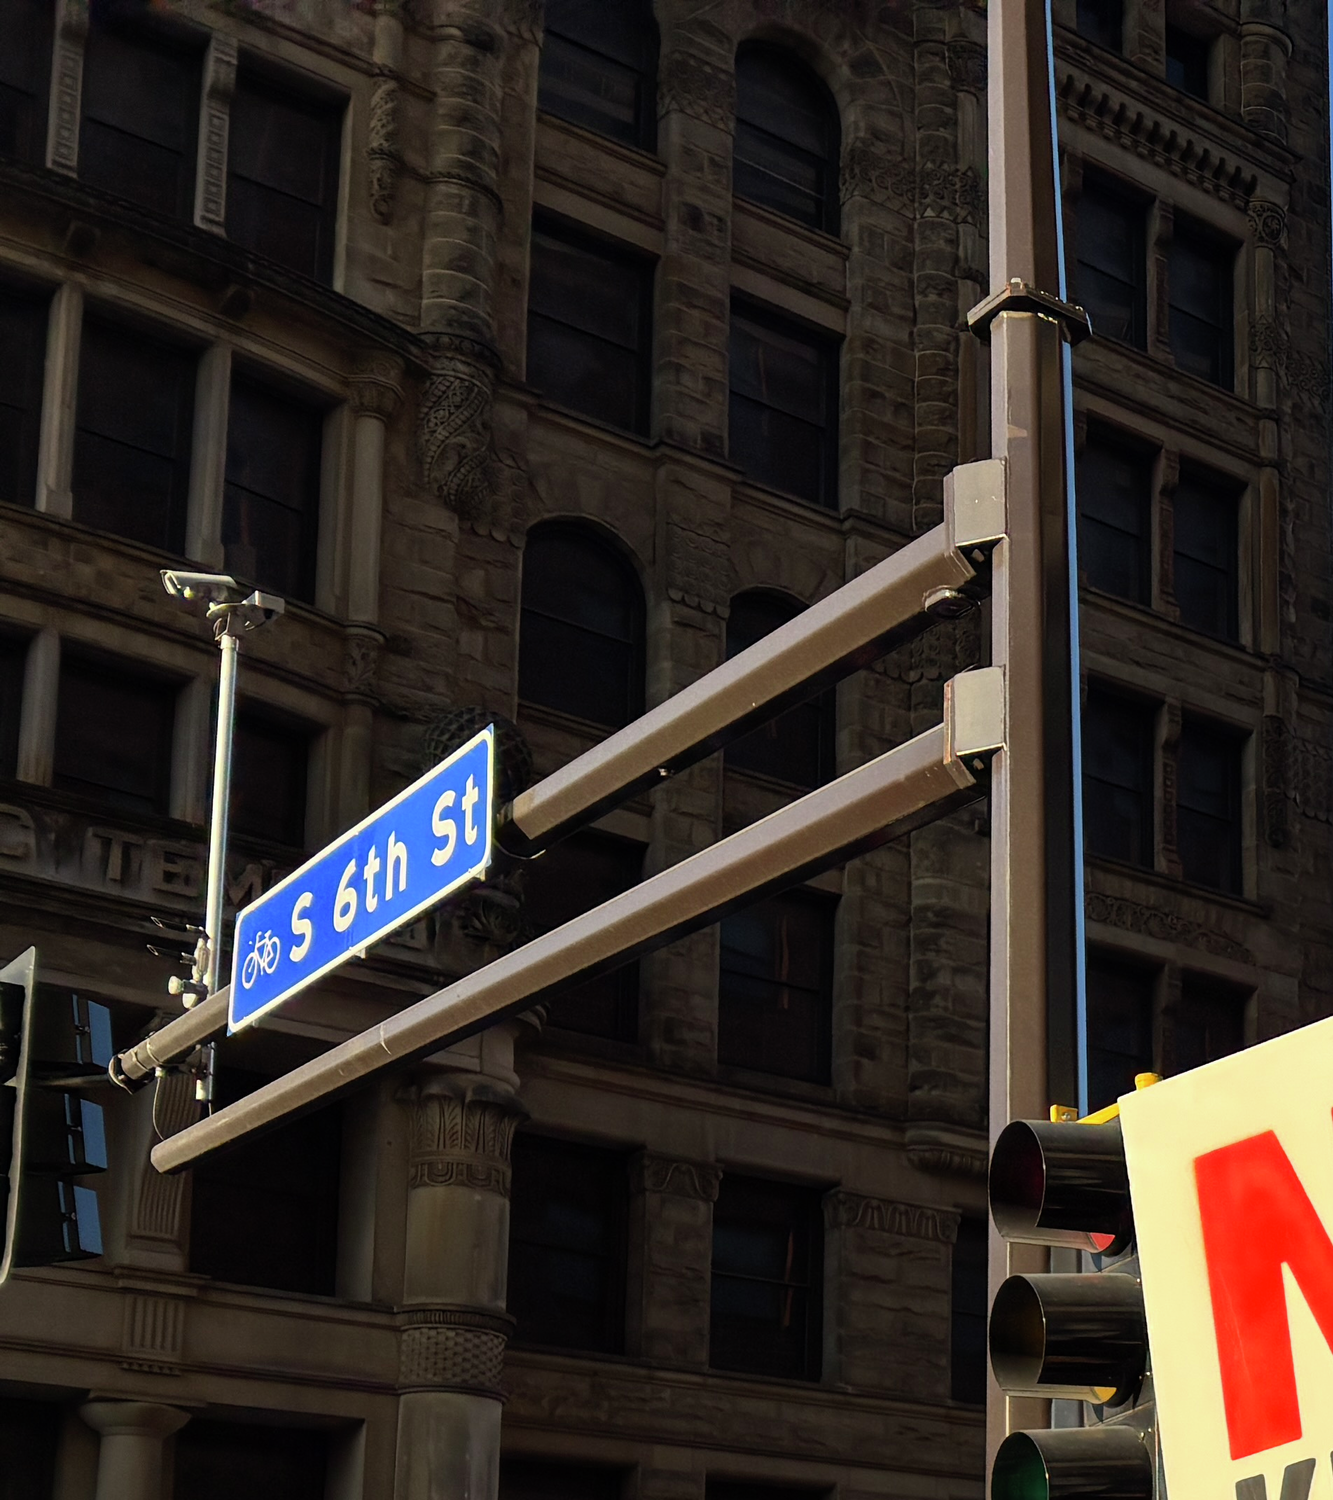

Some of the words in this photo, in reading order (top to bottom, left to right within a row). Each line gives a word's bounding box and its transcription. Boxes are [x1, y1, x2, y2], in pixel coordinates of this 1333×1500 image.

[289, 891, 313, 963] S
[332, 830, 408, 933] 6th
[430, 773, 480, 867] St
